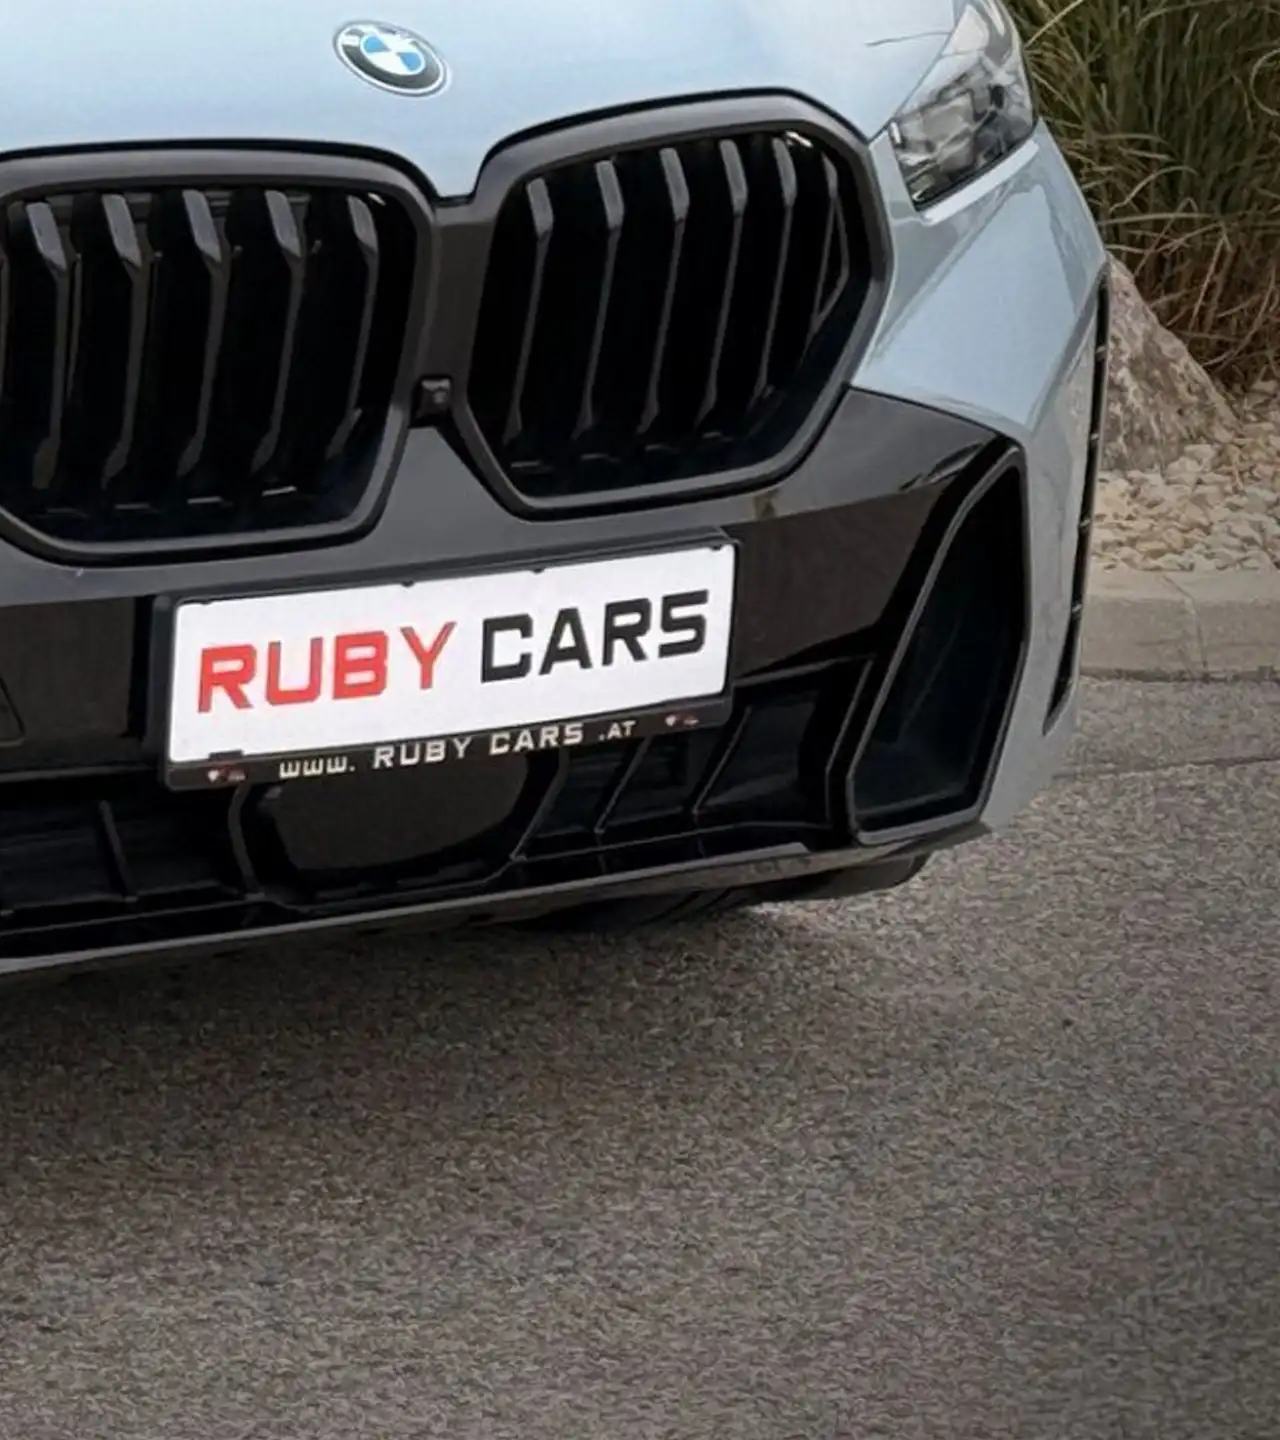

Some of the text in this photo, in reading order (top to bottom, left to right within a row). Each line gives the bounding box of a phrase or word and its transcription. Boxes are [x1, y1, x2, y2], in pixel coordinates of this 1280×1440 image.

[197, 589, 709, 713] RUBY CARS
[372, 736, 472, 770] RUBY
[489, 722, 584, 757] CARS
[597, 720, 637, 742] .AT
